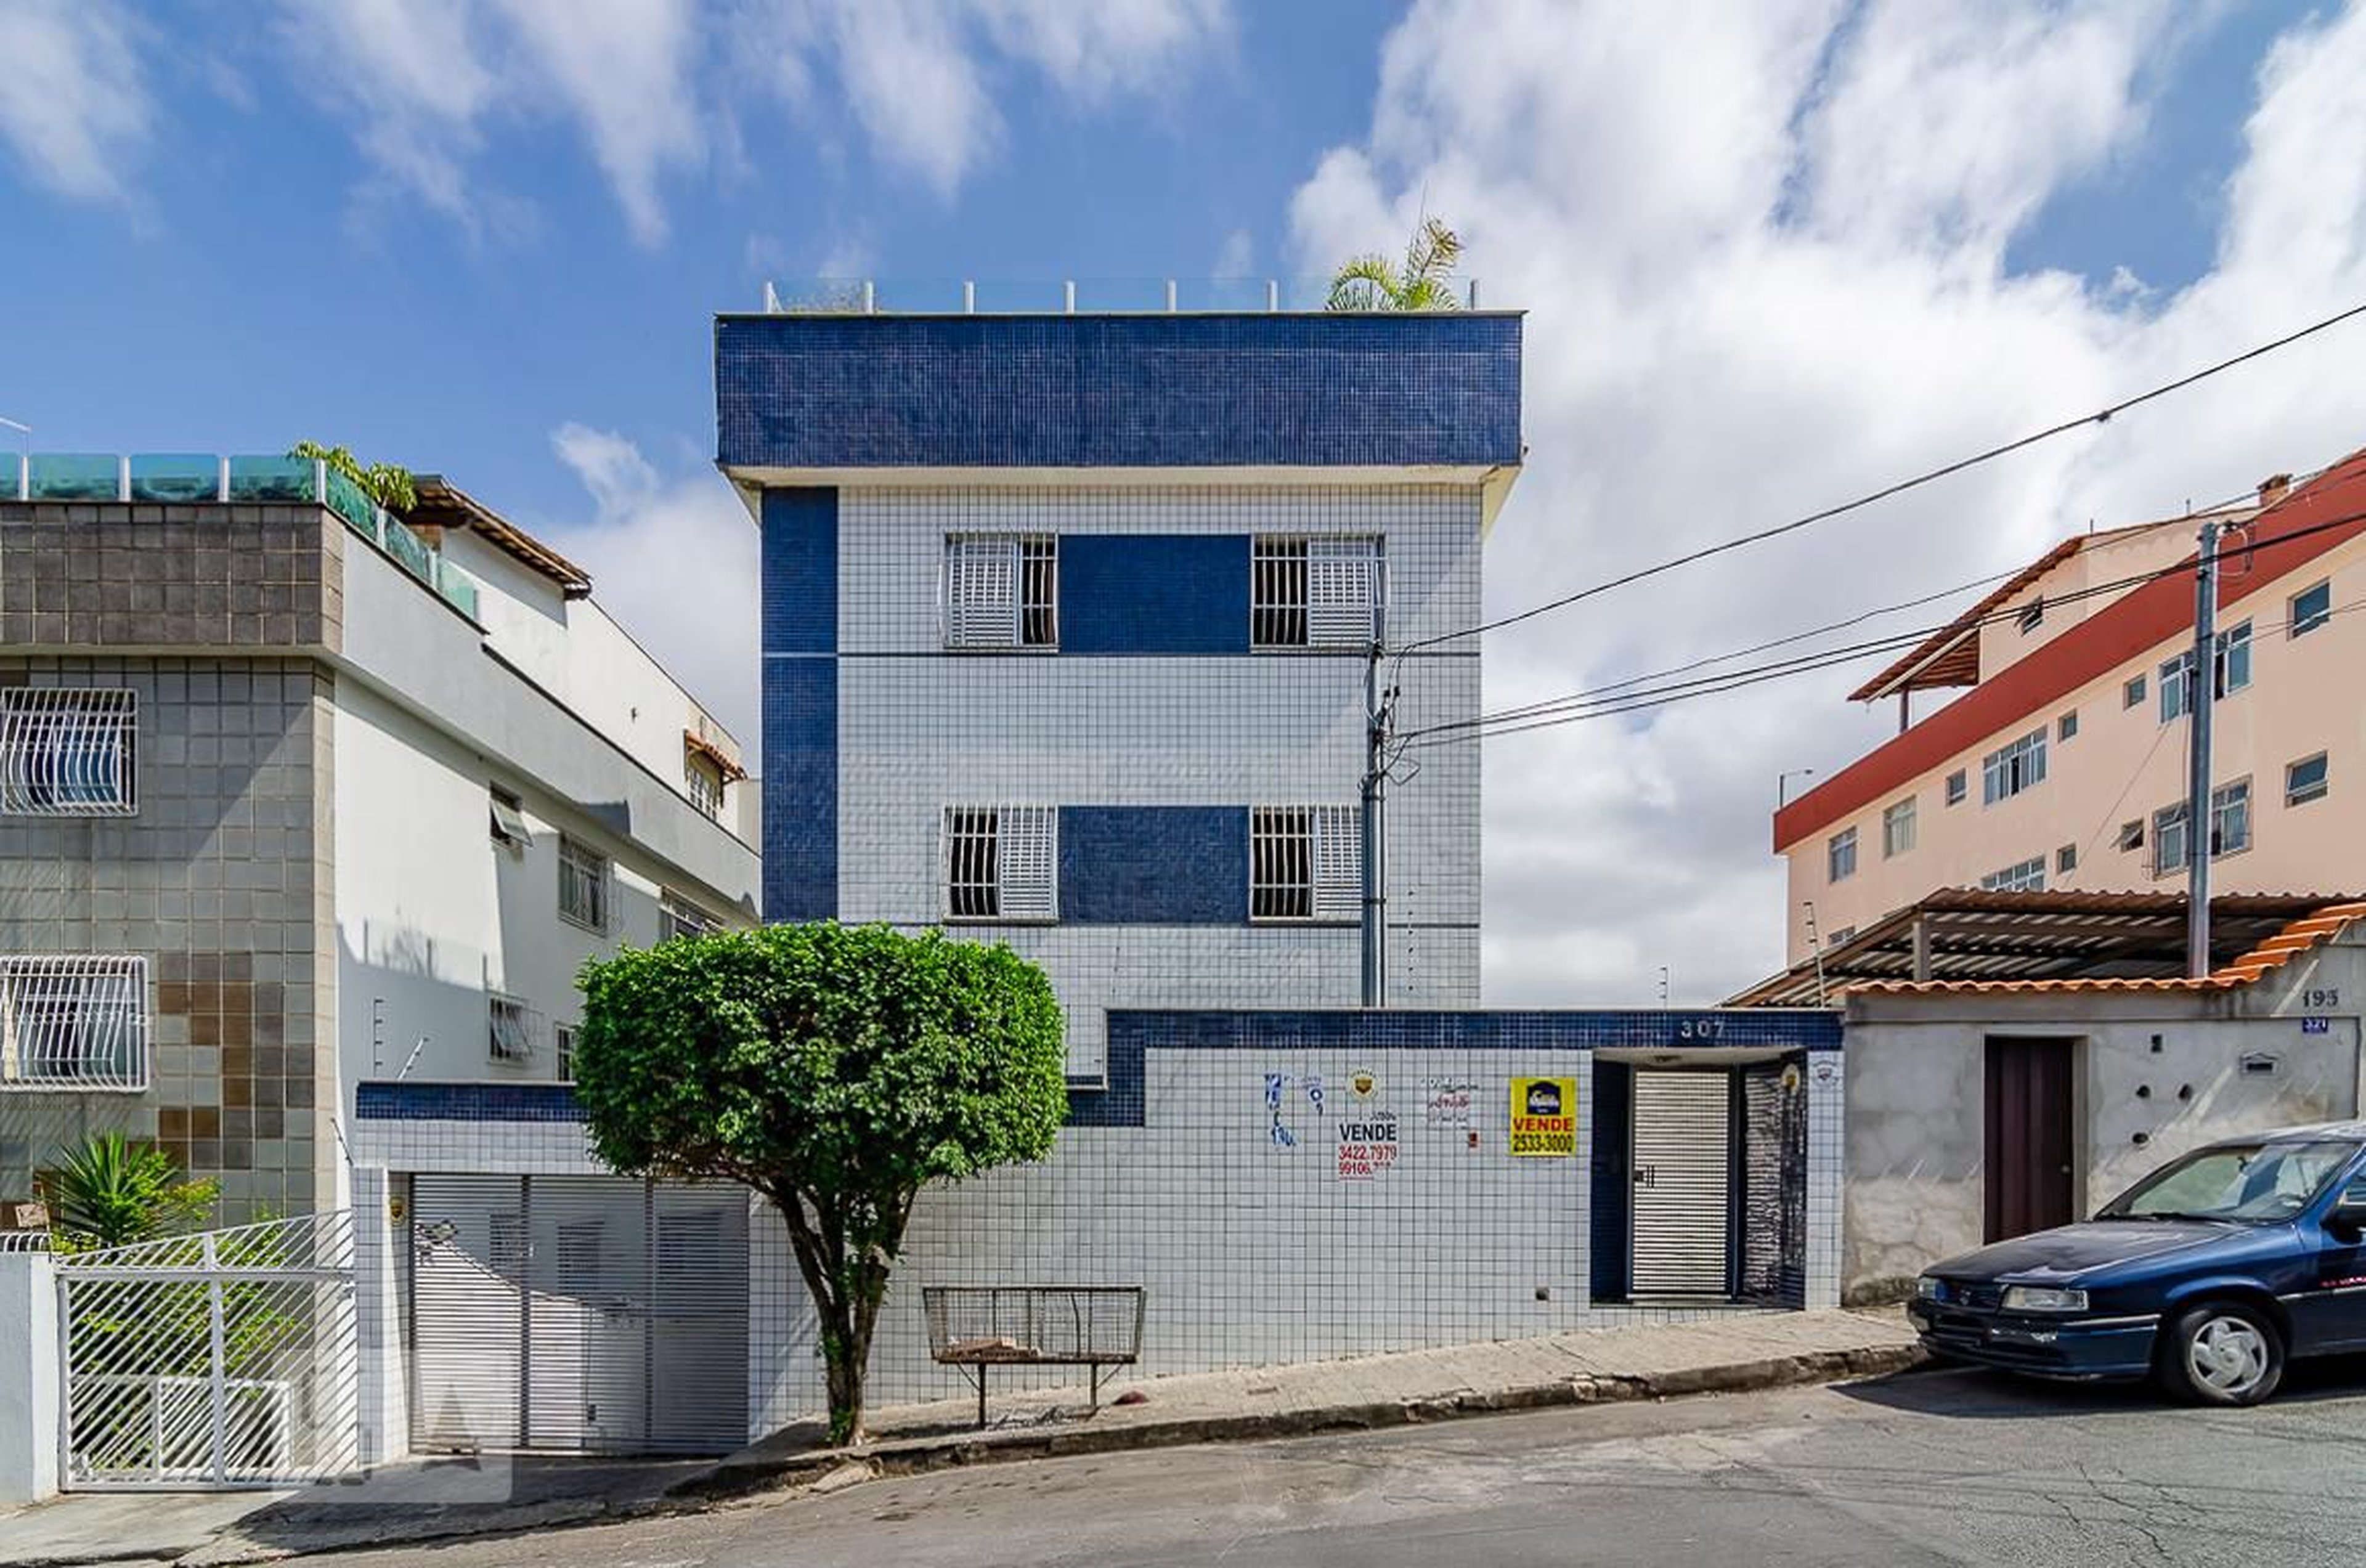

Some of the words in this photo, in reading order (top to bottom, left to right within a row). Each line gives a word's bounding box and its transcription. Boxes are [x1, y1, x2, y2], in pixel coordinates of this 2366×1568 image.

[2302, 988, 2339, 1008] 195
[1681, 1020, 1725, 1039] 307
[1338, 1123, 1397, 1142] VENDE
[1513, 1117, 1574, 1132] VENDE
[1513, 1134, 1574, 1152] 2533-3000
